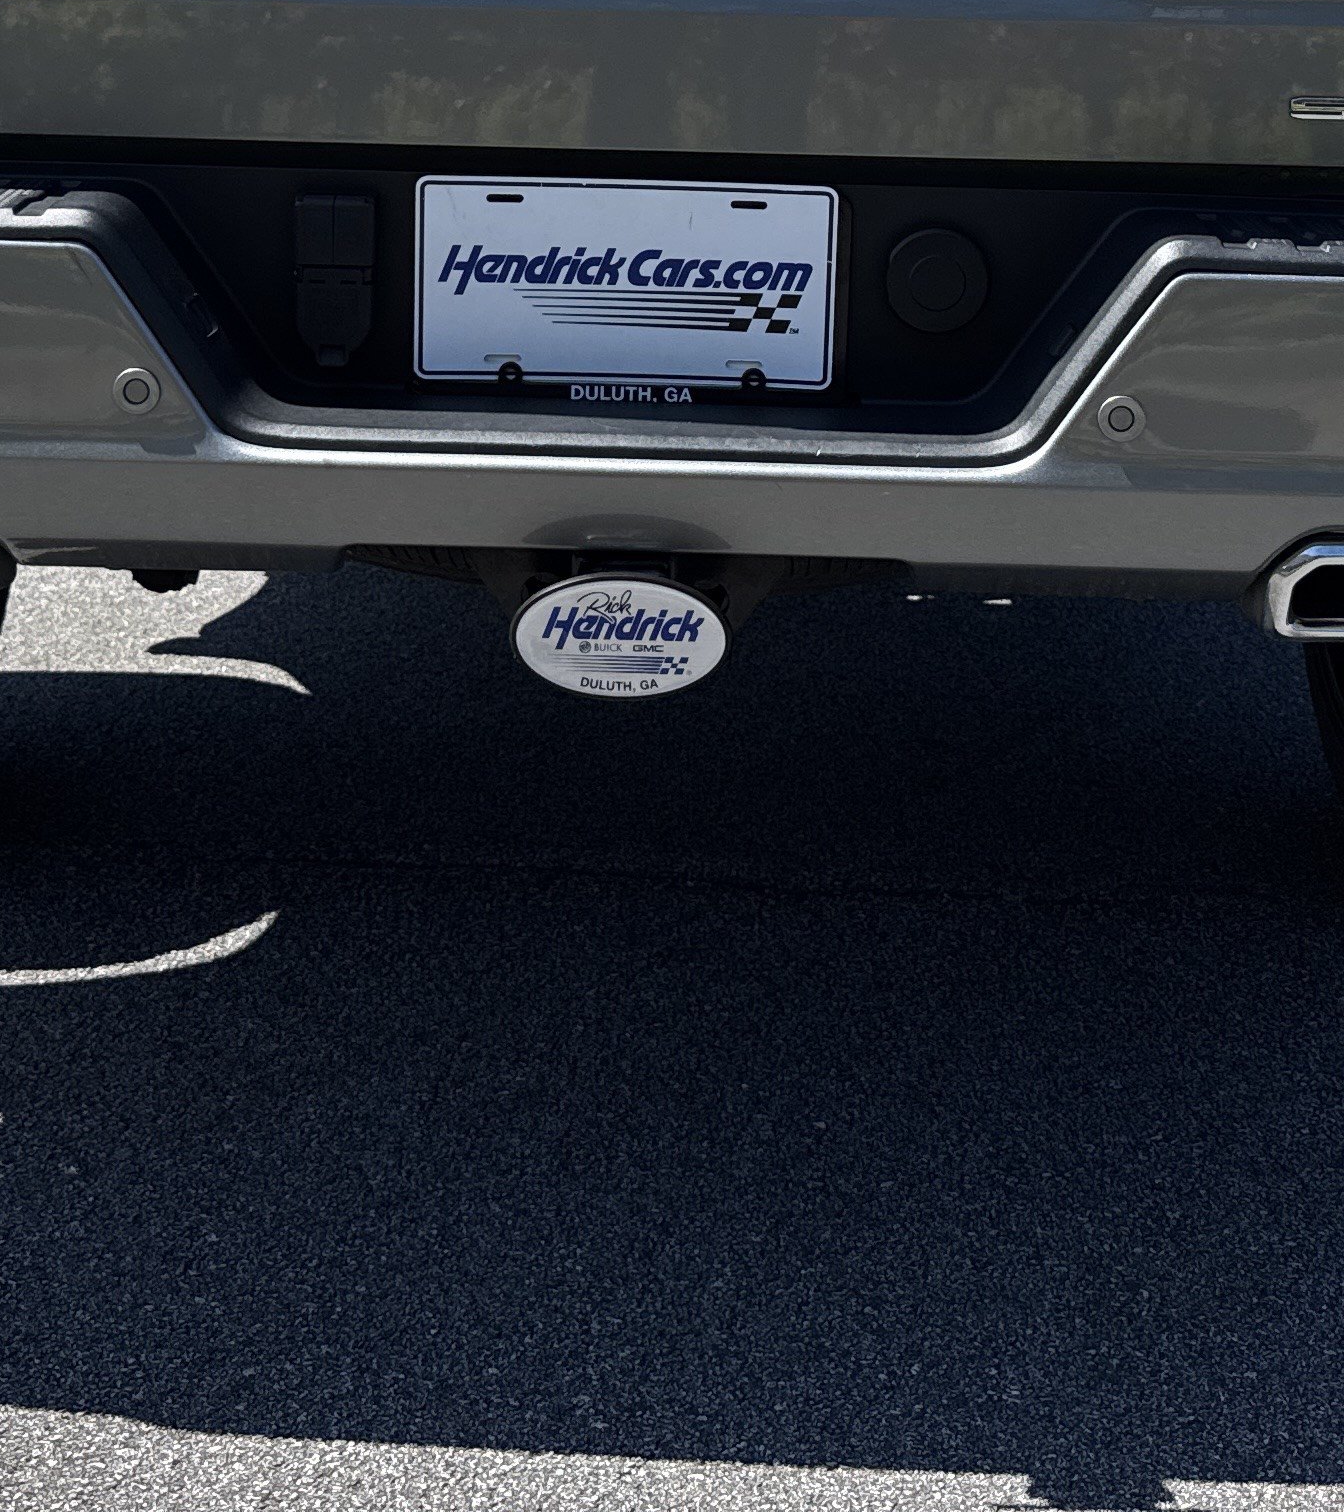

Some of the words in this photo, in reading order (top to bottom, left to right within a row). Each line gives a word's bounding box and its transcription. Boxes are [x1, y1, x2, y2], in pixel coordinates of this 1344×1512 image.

[664, 386, 693, 403] GA
[577, 590, 632, 625] Rick
[541, 606, 705, 650] Hendrick
[593, 643, 623, 652] BUICK
[632, 644, 665, 652] GMC
[579, 676, 637, 693] DULUTH,
[639, 678, 659, 690] GA
